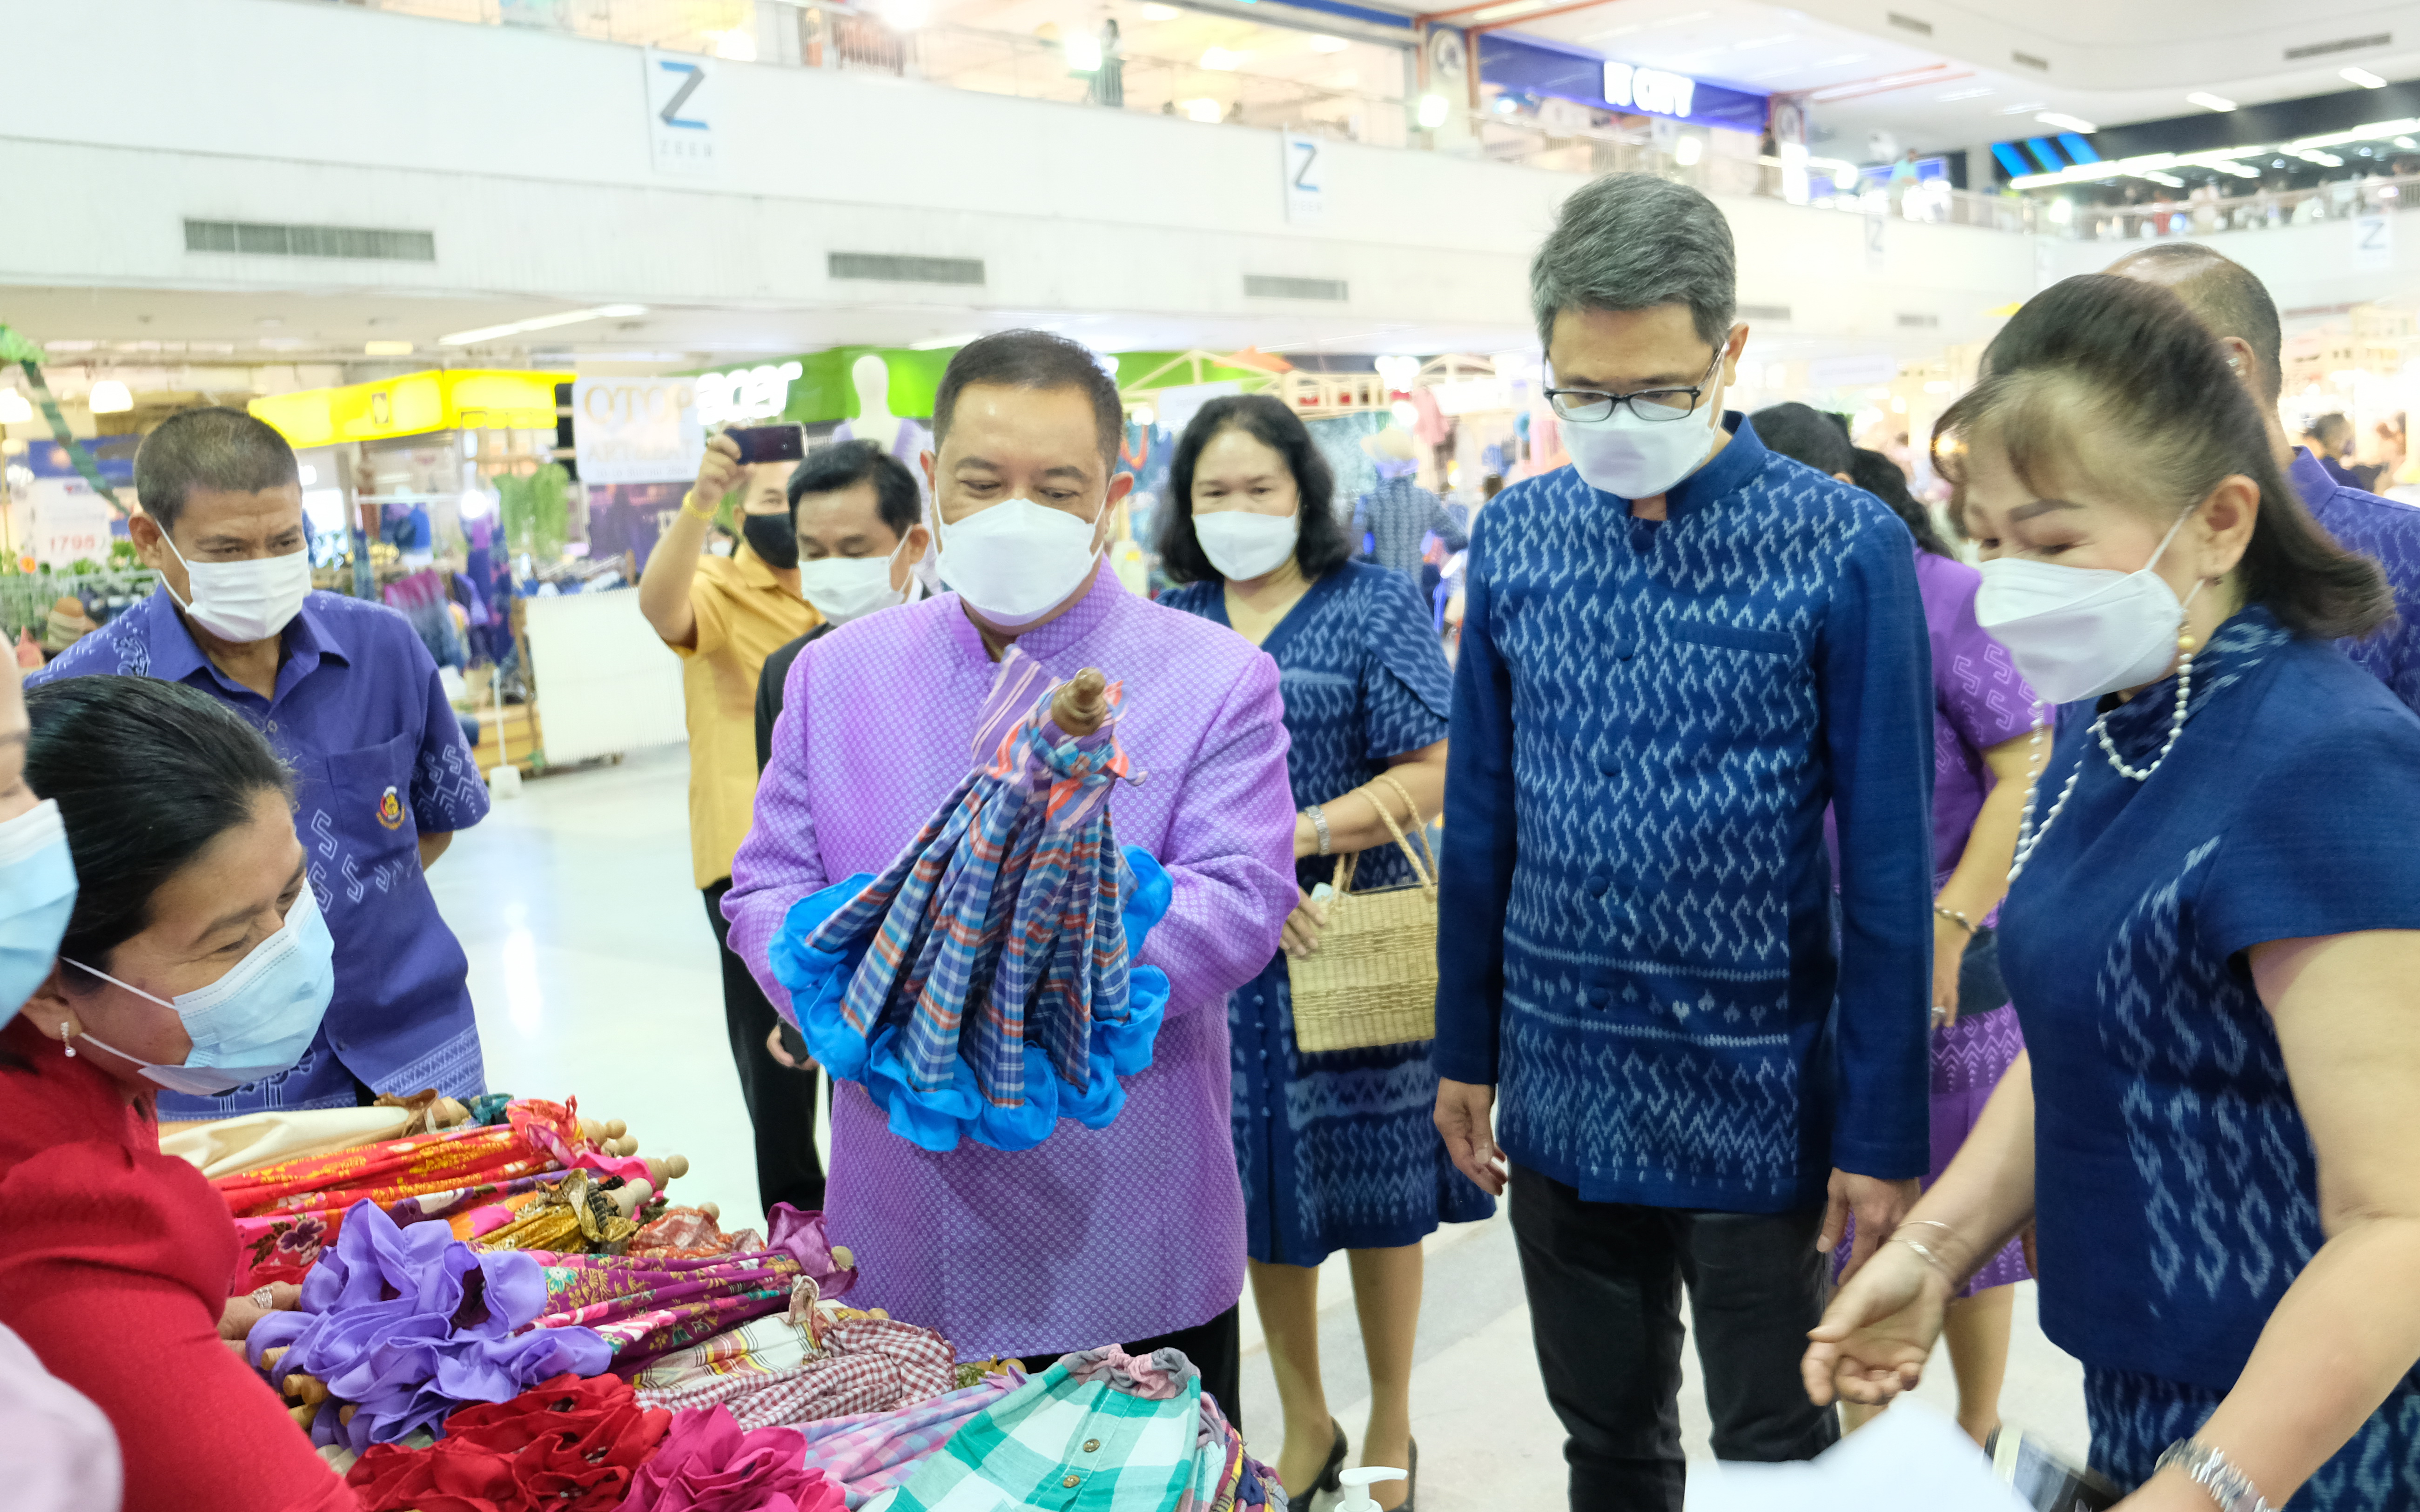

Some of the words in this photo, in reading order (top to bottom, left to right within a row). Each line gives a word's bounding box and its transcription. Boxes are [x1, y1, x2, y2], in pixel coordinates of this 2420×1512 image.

[659, 61, 709, 129] Z
[1293, 142, 1319, 191] Z
[584, 384, 694, 424] OTOP
[696, 362, 803, 425] acer
